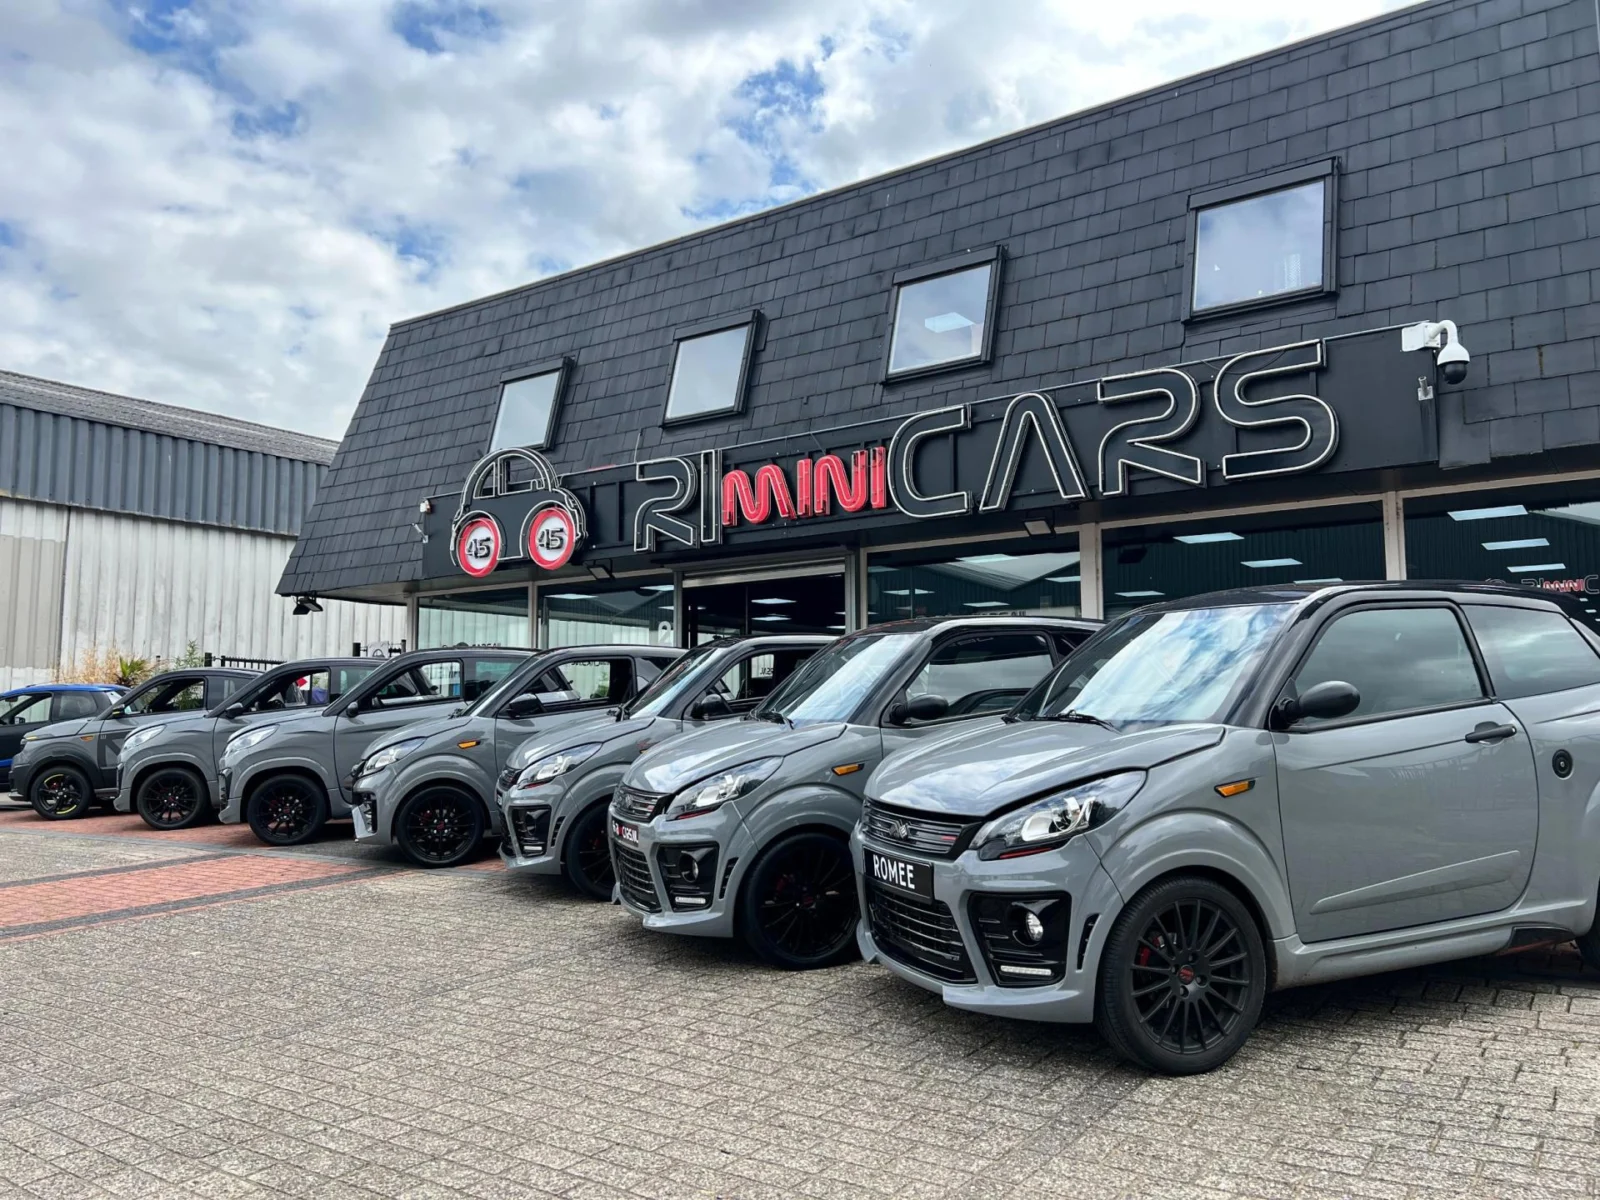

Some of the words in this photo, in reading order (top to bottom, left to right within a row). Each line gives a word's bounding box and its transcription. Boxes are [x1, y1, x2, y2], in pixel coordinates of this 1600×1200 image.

[888, 338, 1338, 517] CARS
[466, 537, 493, 559] 45
[538, 527, 566, 550] 45
[873, 854, 916, 890] ROMEE
